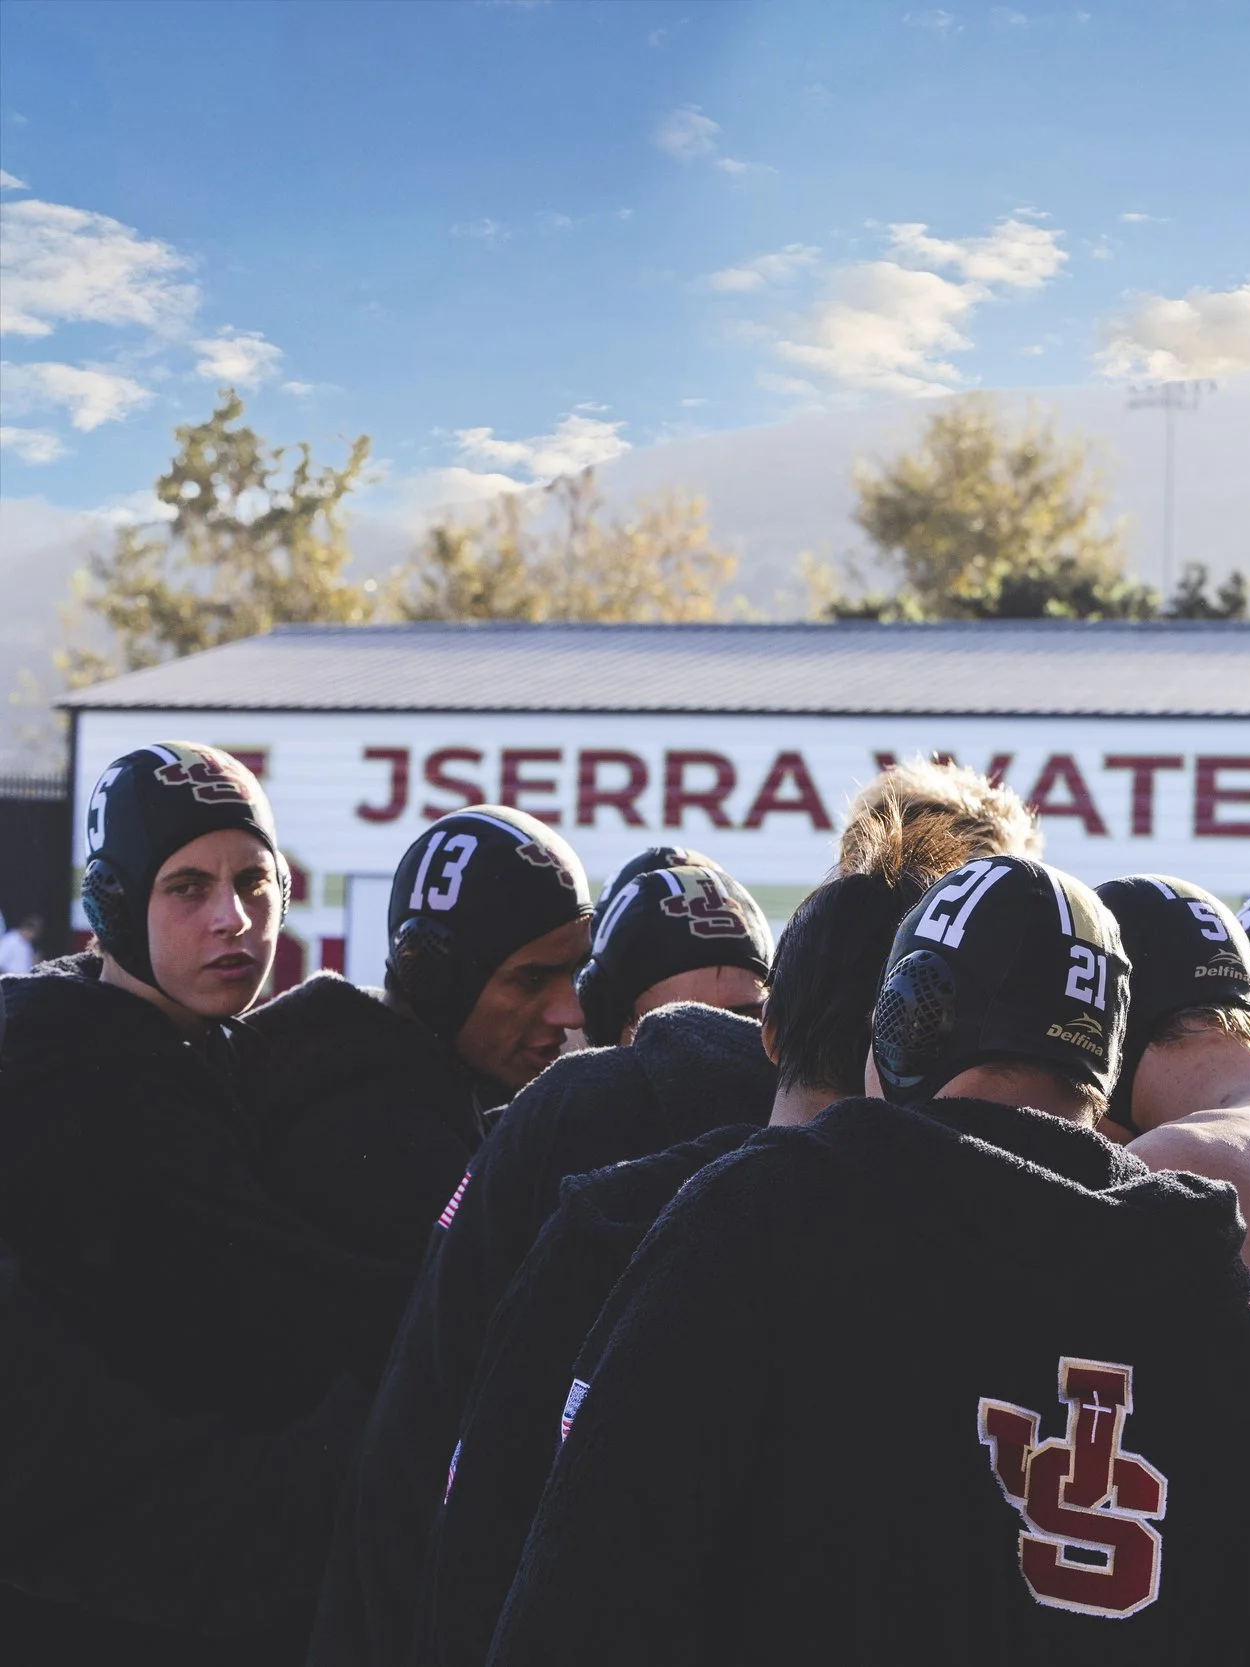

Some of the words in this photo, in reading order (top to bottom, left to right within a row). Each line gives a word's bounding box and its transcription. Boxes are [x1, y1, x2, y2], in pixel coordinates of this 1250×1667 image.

[356, 746, 835, 831] JSERRA
[409, 830, 478, 911] 13
[913, 859, 1013, 949] 21
[1186, 901, 1229, 942] 5
[1064, 943, 1107, 1012] 21
[1193, 965, 1250, 983] Delfina
[1046, 1023, 1104, 1057] Delfina
